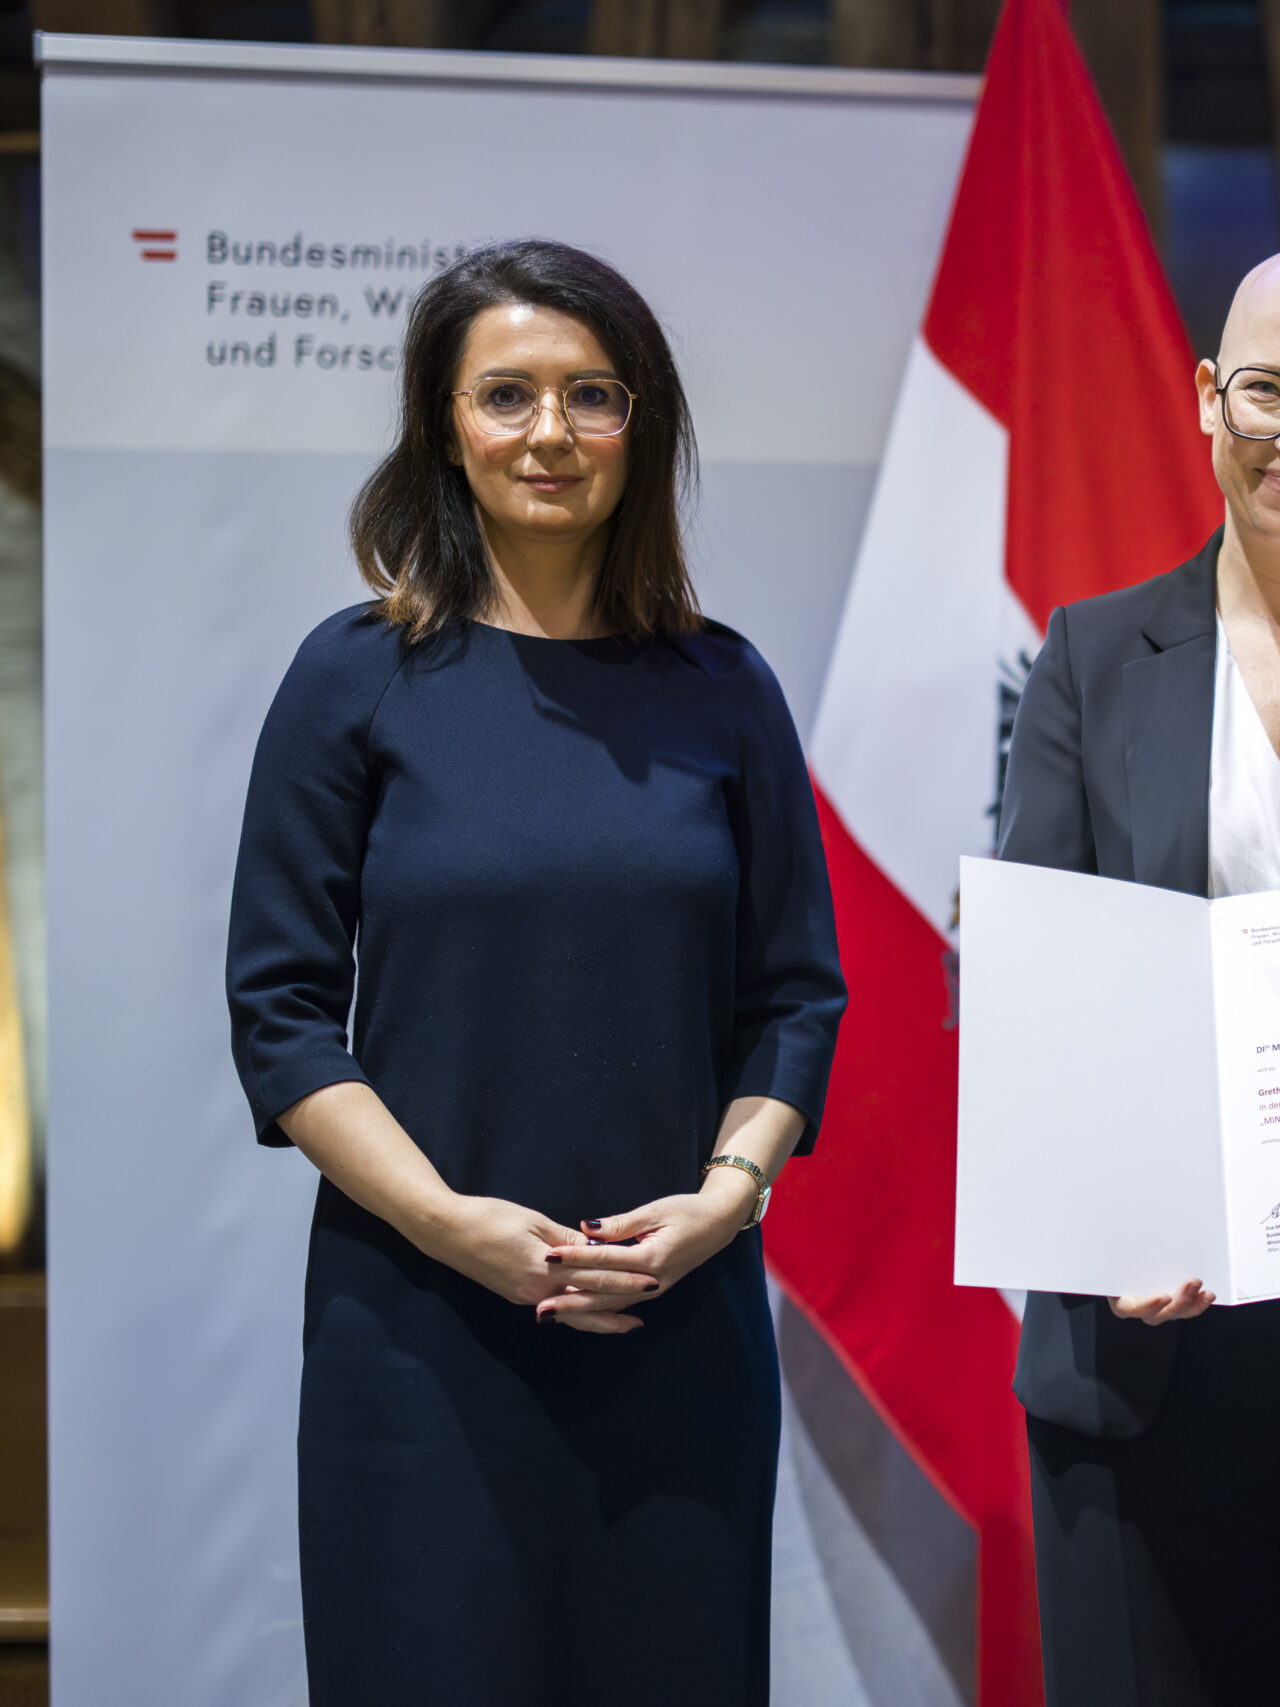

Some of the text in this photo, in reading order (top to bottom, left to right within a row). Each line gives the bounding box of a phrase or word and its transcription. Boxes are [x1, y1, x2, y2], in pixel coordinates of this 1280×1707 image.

[207, 230, 468, 271] Bundesminist
[207, 280, 350, 325] Frauen,
[206, 331, 398, 371] und Forsc
[1259, 1103, 1267, 1111] in
